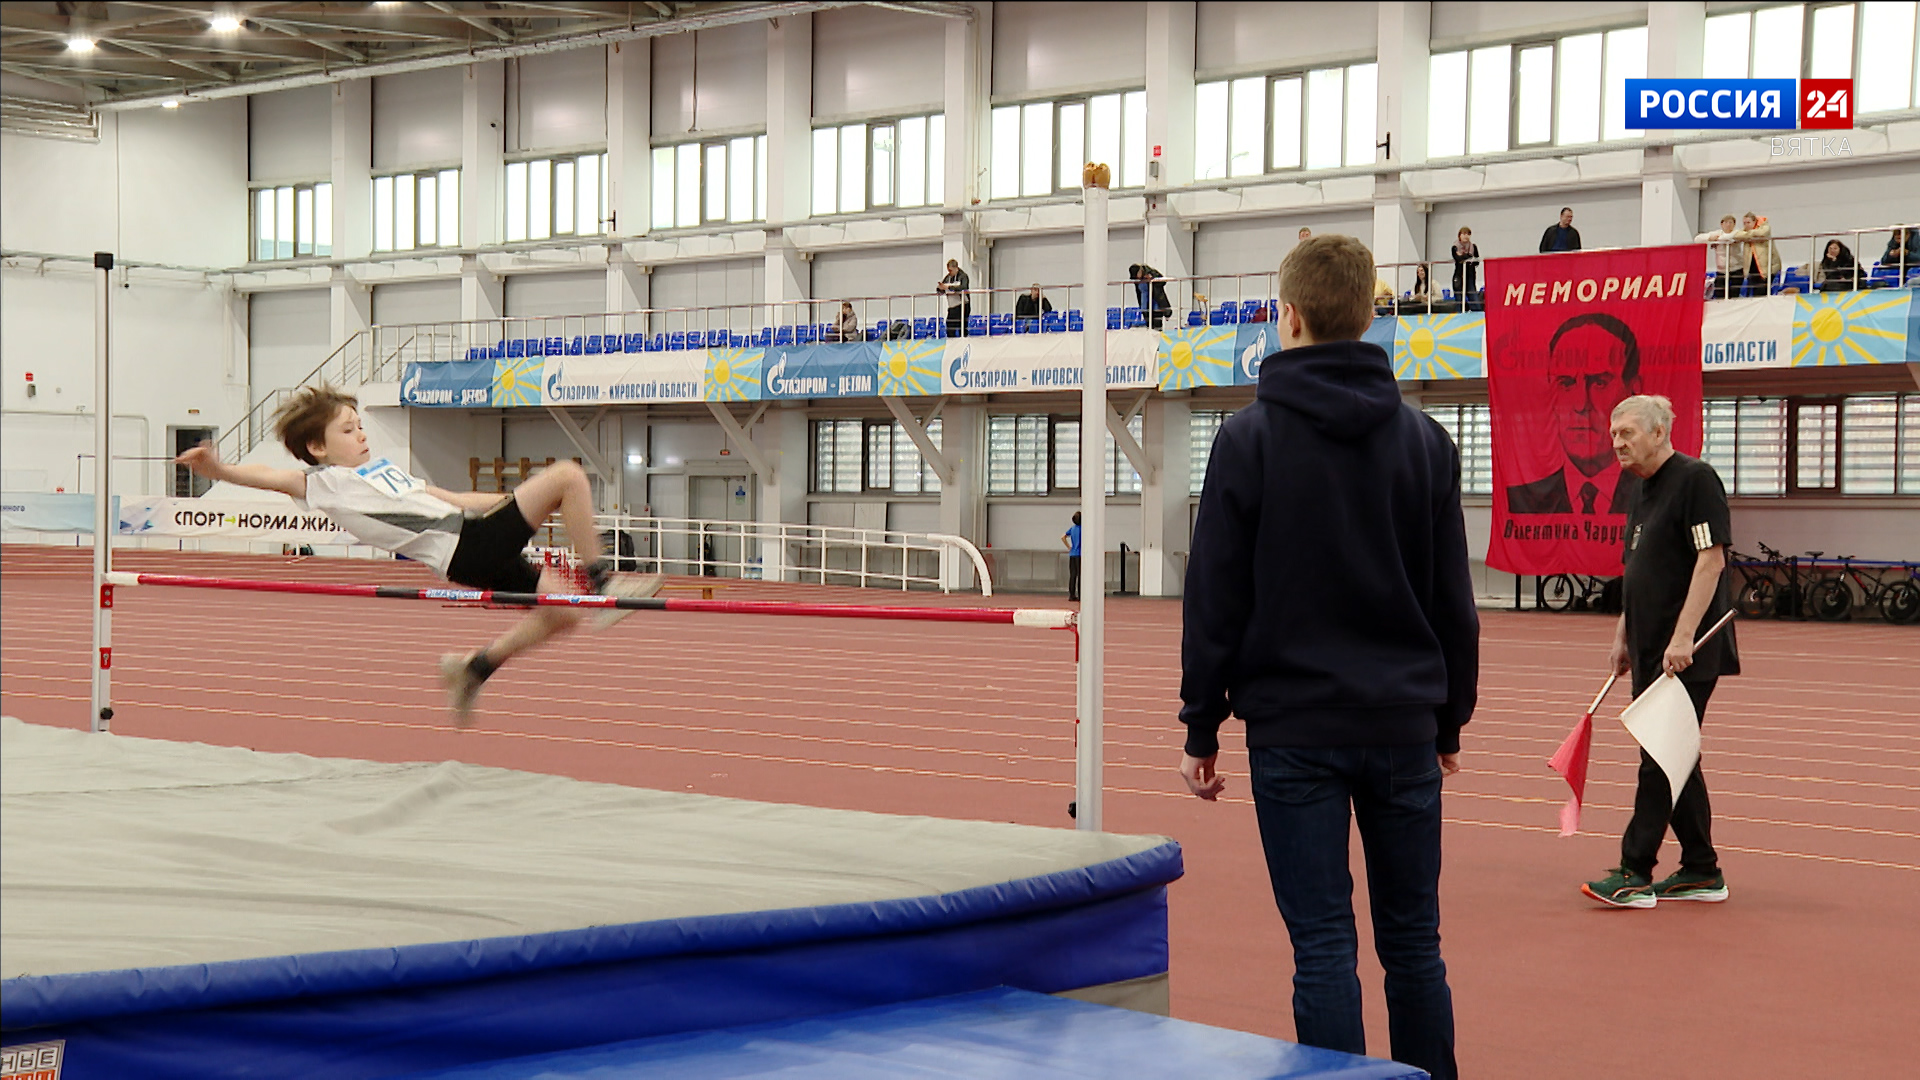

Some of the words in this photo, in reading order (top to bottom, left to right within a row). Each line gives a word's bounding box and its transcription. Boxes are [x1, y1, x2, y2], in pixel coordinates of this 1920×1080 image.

[1503, 272, 1688, 307] МЕМОРИАЛ
[1704, 339, 1777, 364] ОБЛАСТИ
[784, 377, 828, 394] ГАЗПРОМ
[838, 375, 872, 396] ДЕТЯМ
[969, 369, 1018, 388] ГАЗПРОМ
[1031, 366, 1084, 386] КИРОВСК
[1105, 364, 1147, 384] БЛАСТИ
[562, 385, 600, 400] ГАЗПРОМ
[609, 379, 657, 400] КИРОВСКОЙ
[659, 381, 698, 399] ОБЛАСТИ
[174, 511, 225, 528] СПОРТ
[238, 513, 298, 530] НОРМА
[1503, 518, 1579, 541] Валентина
